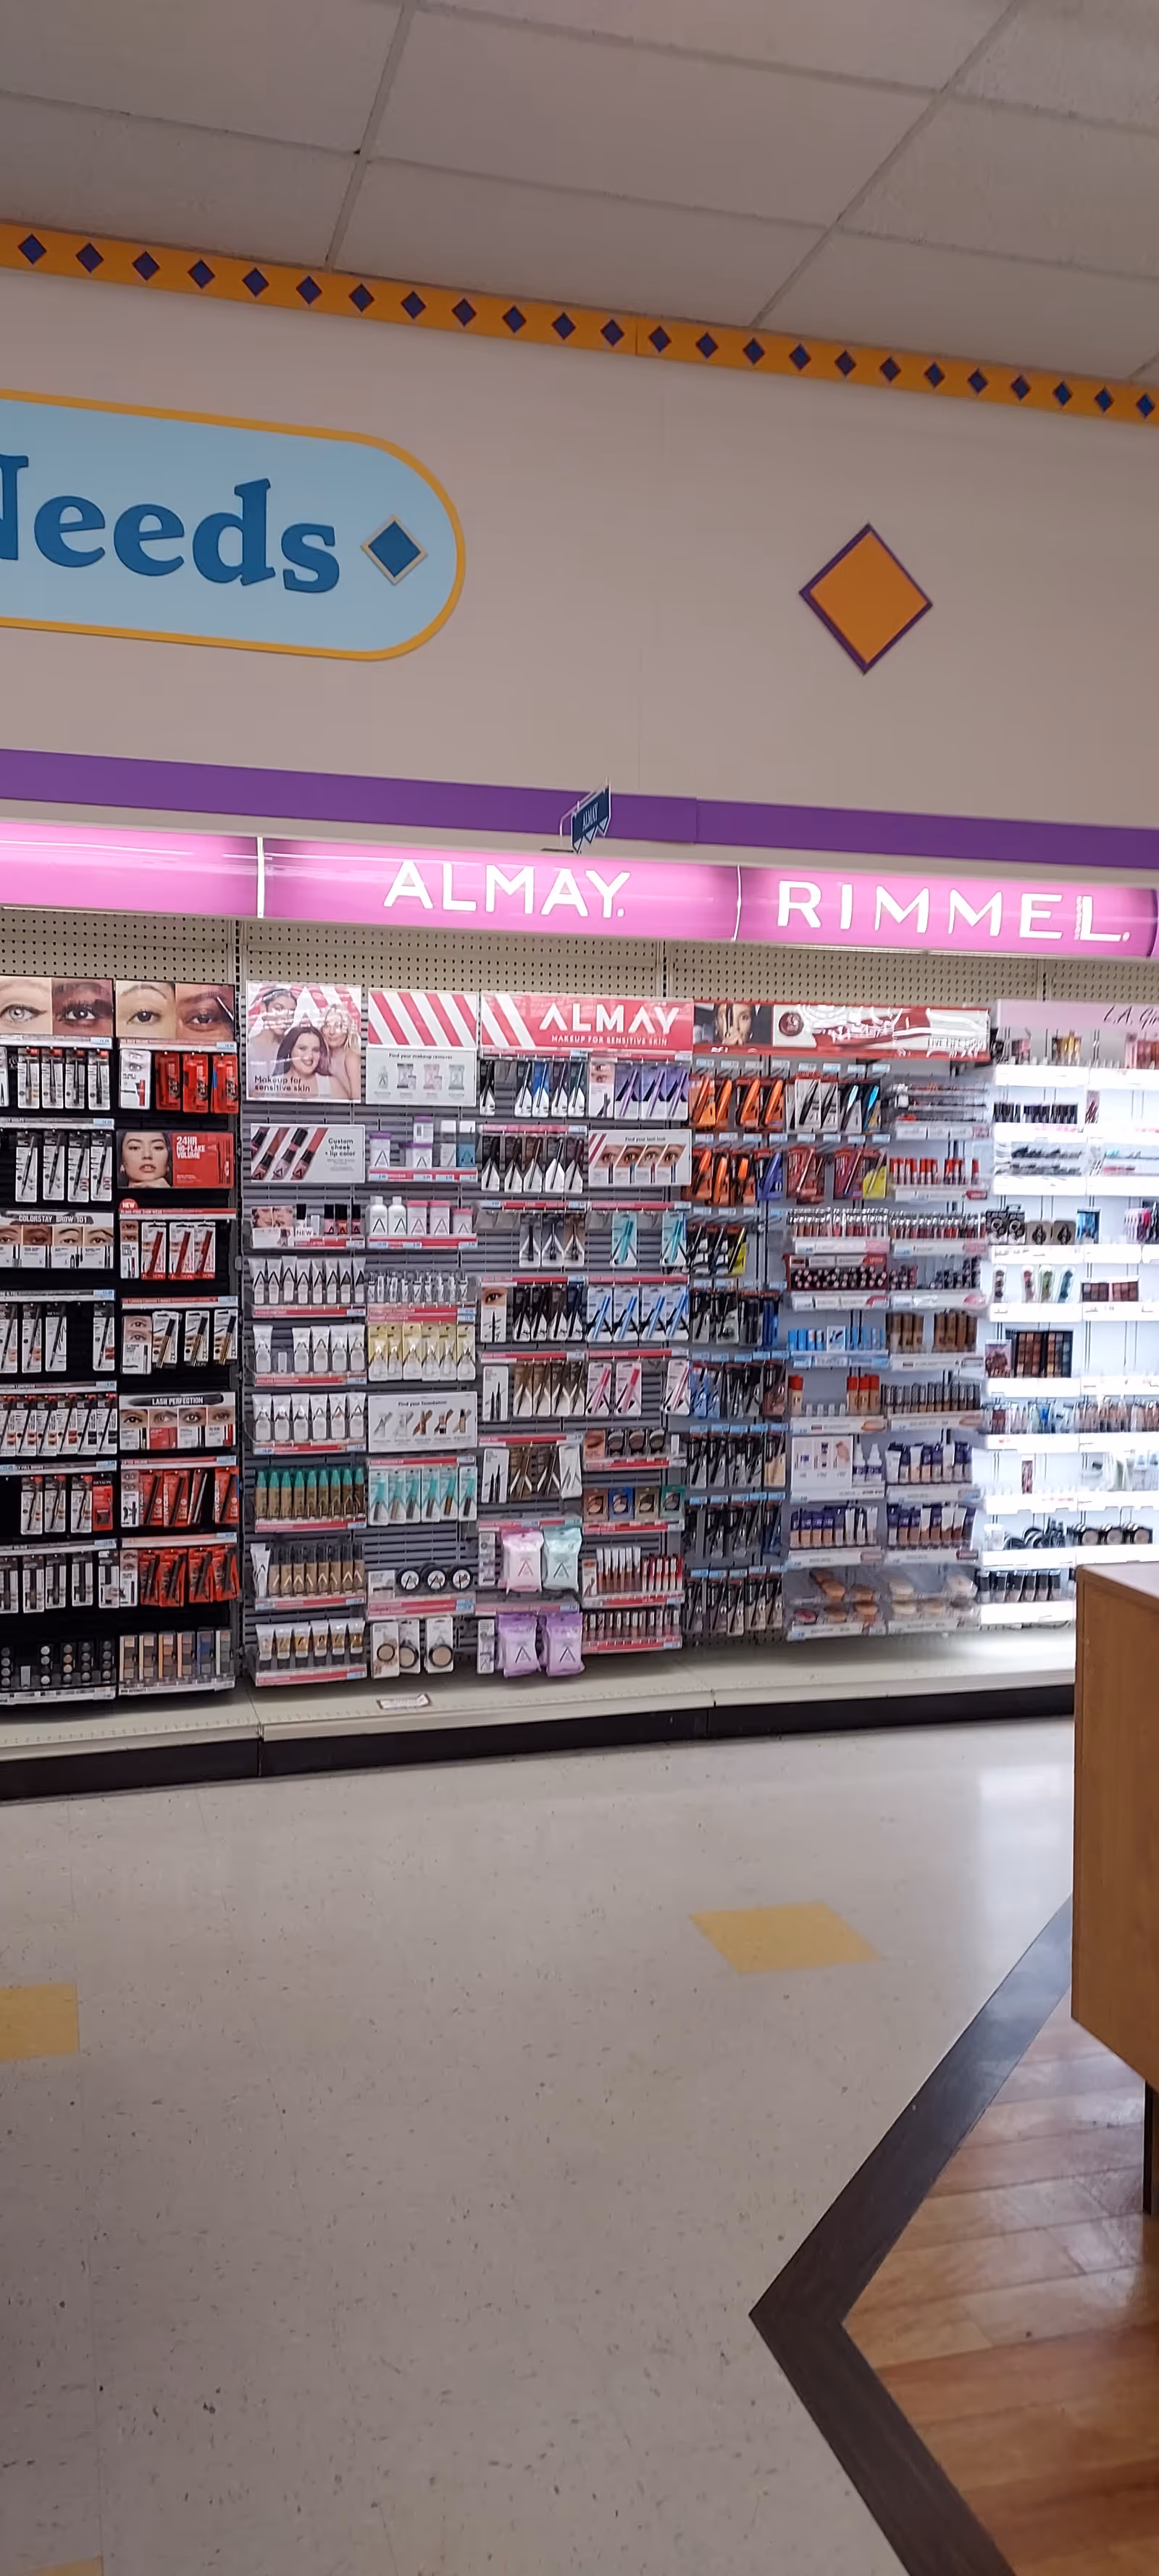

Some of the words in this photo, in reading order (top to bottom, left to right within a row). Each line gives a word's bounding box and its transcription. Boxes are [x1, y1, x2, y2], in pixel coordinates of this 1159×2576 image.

[582, 802, 598, 832] ALMAY
[539, 1002, 679, 1034] ALMAY
[1103, 1004, 1133, 1026] L.A.
[606, 1036, 646, 1045] SENSITIVE
[255, 1076, 288, 1084] Makeup
[176, 1136, 197, 1145] 24HR
[177, 1144, 206, 1153] NO-FLAKE
[18, 1214, 53, 1223] COLORSTAY
[169, 1397, 204, 1405] PERFECTION
